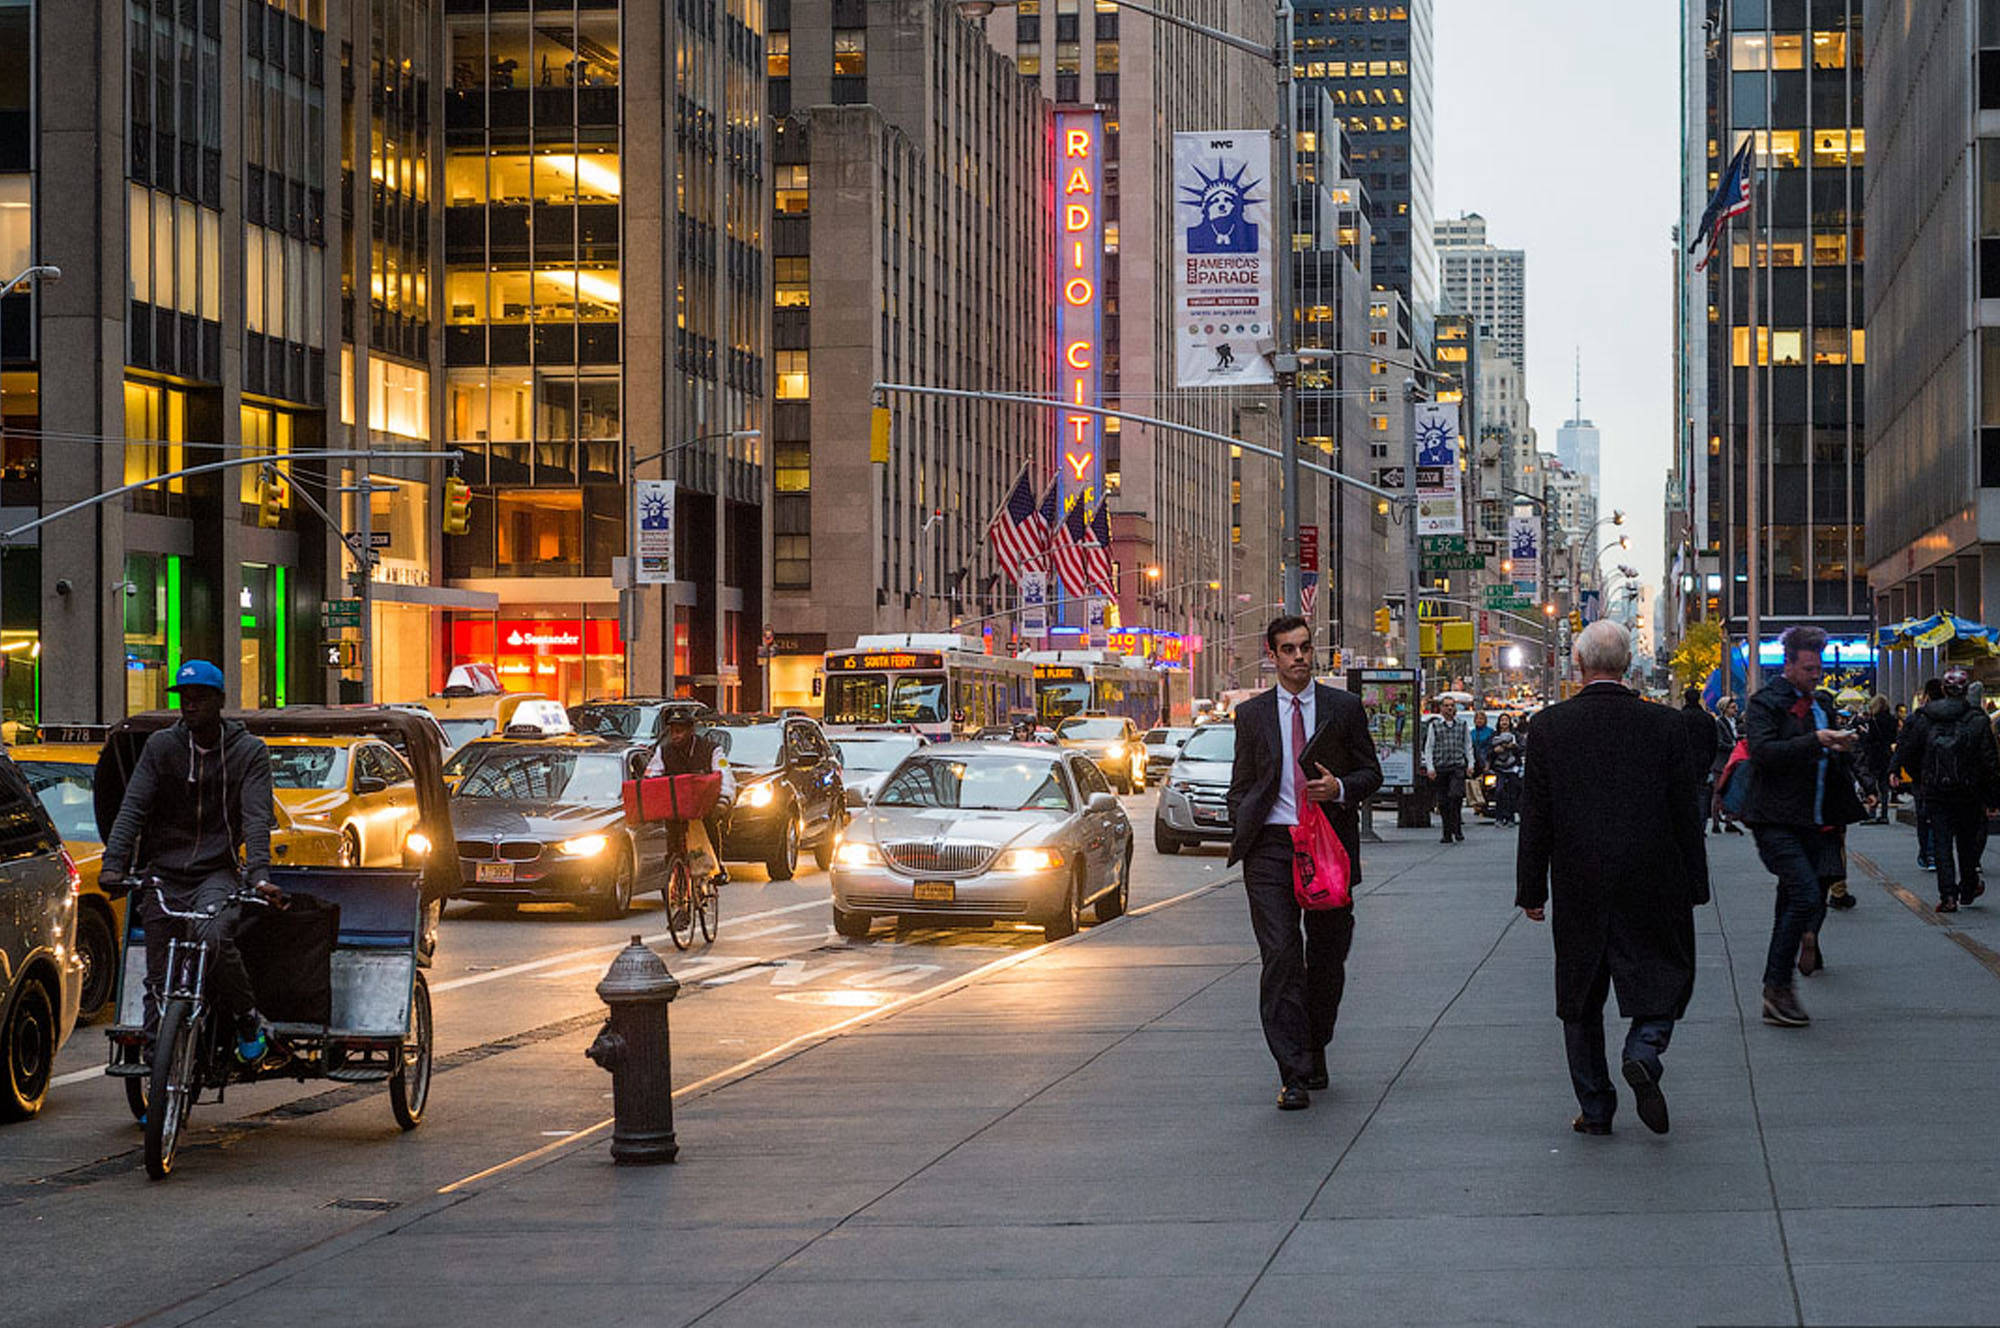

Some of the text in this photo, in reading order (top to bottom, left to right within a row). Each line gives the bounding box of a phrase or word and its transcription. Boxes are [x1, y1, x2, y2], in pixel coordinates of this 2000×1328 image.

[1210, 140, 1233, 149] NYC
[1064, 129, 1093, 305] RADIO
[1199, 271, 1259, 284] PARADE
[1065, 340, 1092, 480] CITY
[1423, 538, 1433, 551] W
[1437, 536, 1452, 552] 52
[524, 631, 579, 645] Santander
[864, 655, 890, 668] SOUTH
[891, 655, 917, 668] FERRY
[61, 728, 90, 742] 7F78
